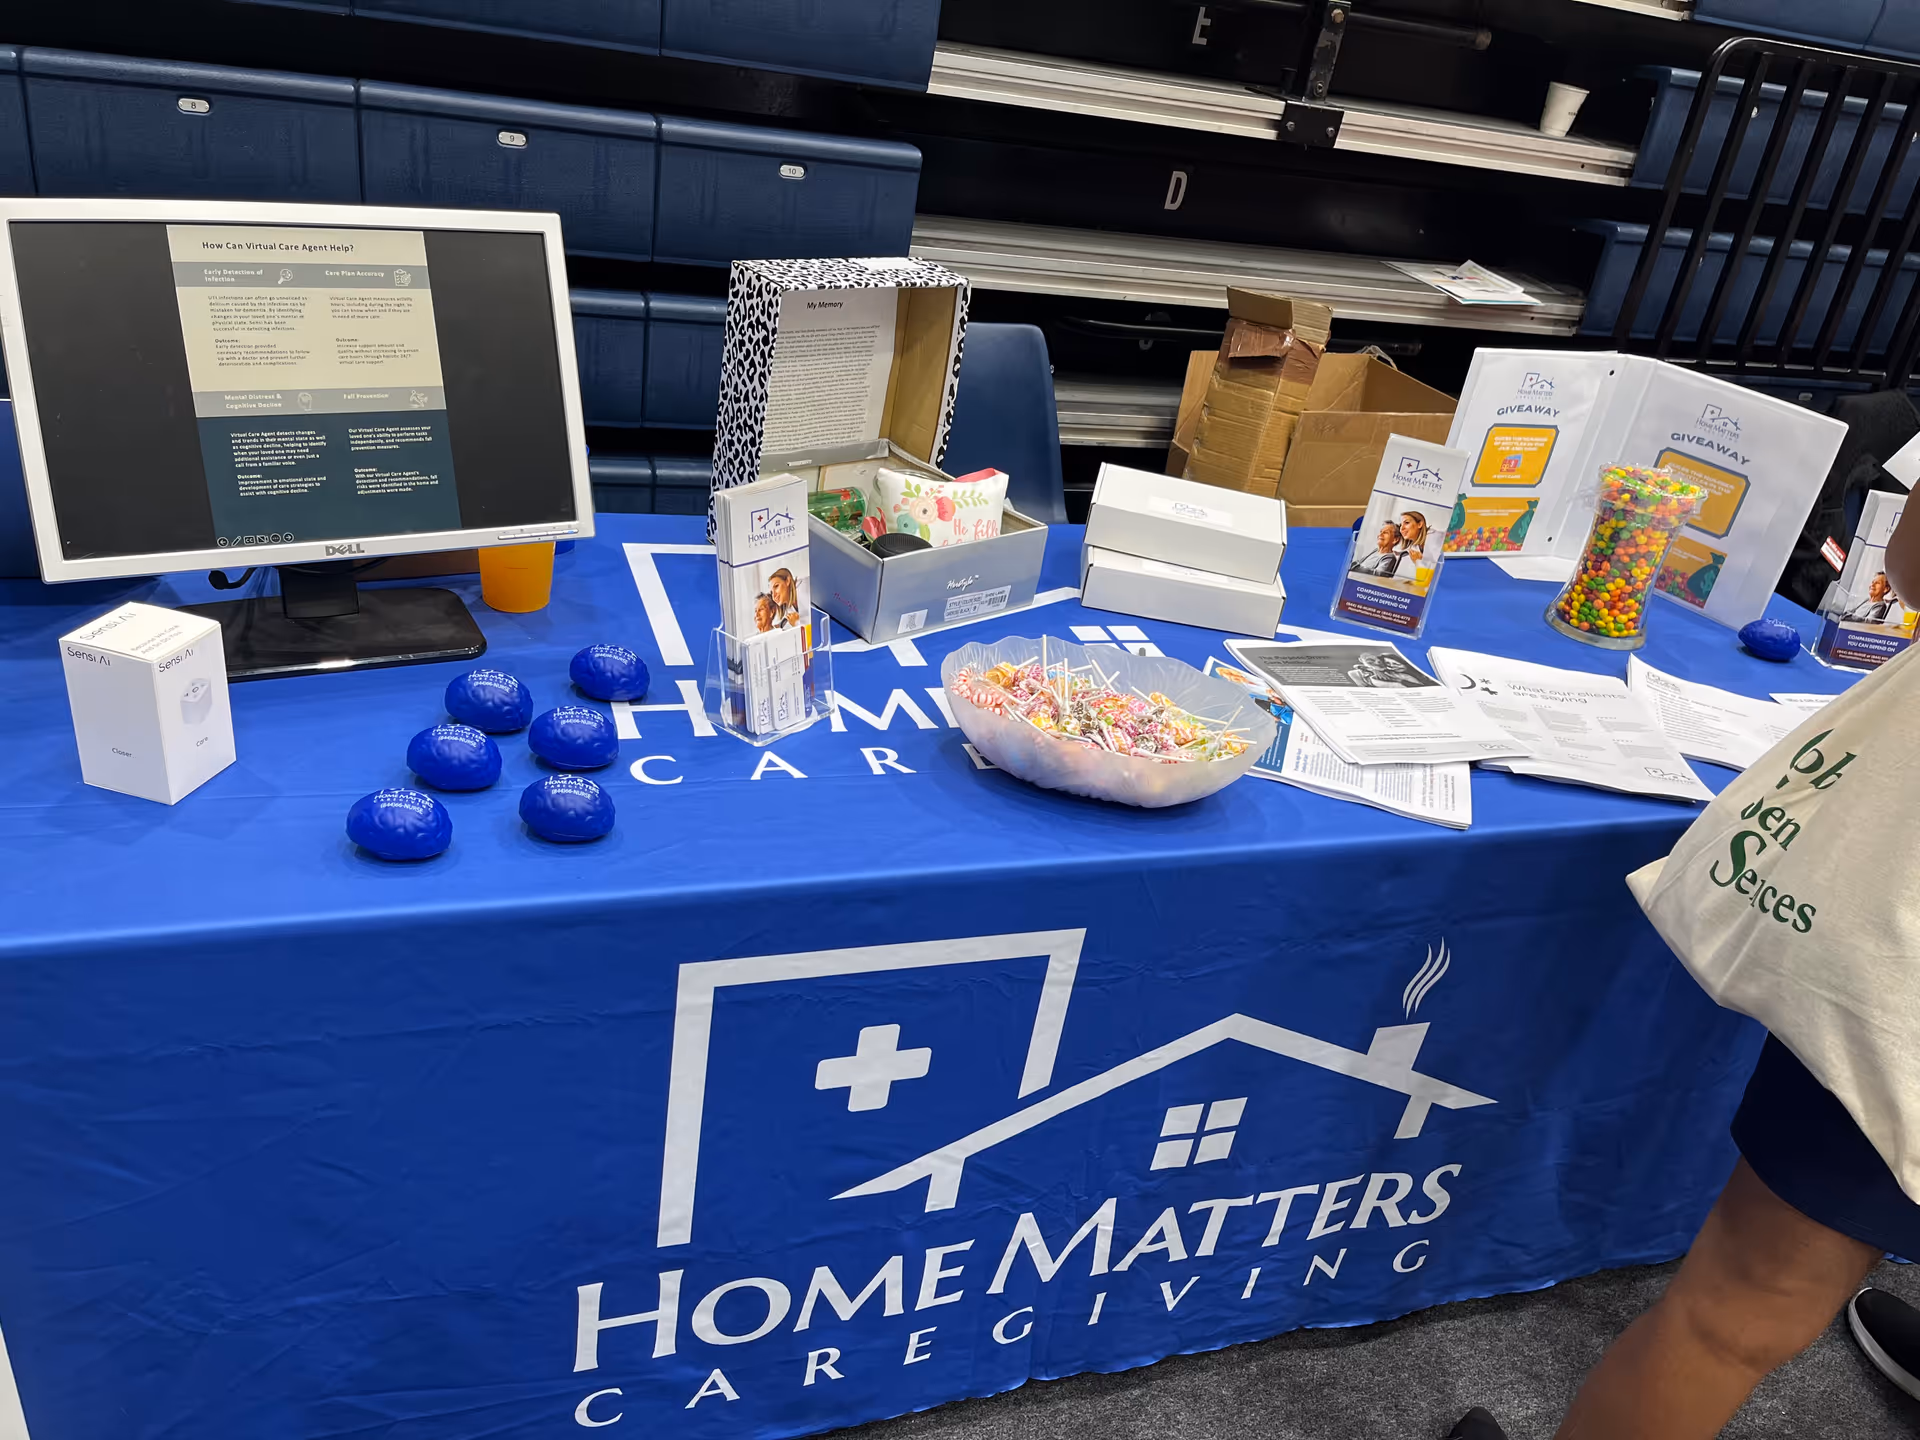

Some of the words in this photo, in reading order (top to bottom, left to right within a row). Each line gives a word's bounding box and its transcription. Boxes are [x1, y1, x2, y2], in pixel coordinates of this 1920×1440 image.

[191, 101, 196, 109] 8
[1164, 170, 1187, 210] D
[202, 241, 223, 249] How
[226, 242, 243, 250] Can
[279, 243, 299, 251] Care
[302, 244, 328, 252] Agent
[330, 244, 354, 252] Help?
[807, 301, 817, 310] My
[818, 301, 843, 309] Memory
[1496, 405, 1560, 417] GIVEAWAY
[1671, 432, 1750, 465] GIVEAWAY
[953, 518, 967, 537] He
[325, 543, 365, 557] DELL
[1357, 587, 1397, 600] COMPASSIONATE
[1379, 599, 1398, 608] DEPEND
[1507, 684, 1546, 693] What
[1540, 695, 1587, 703] saying
[574, 1239, 1429, 1427] CAREGIVING
